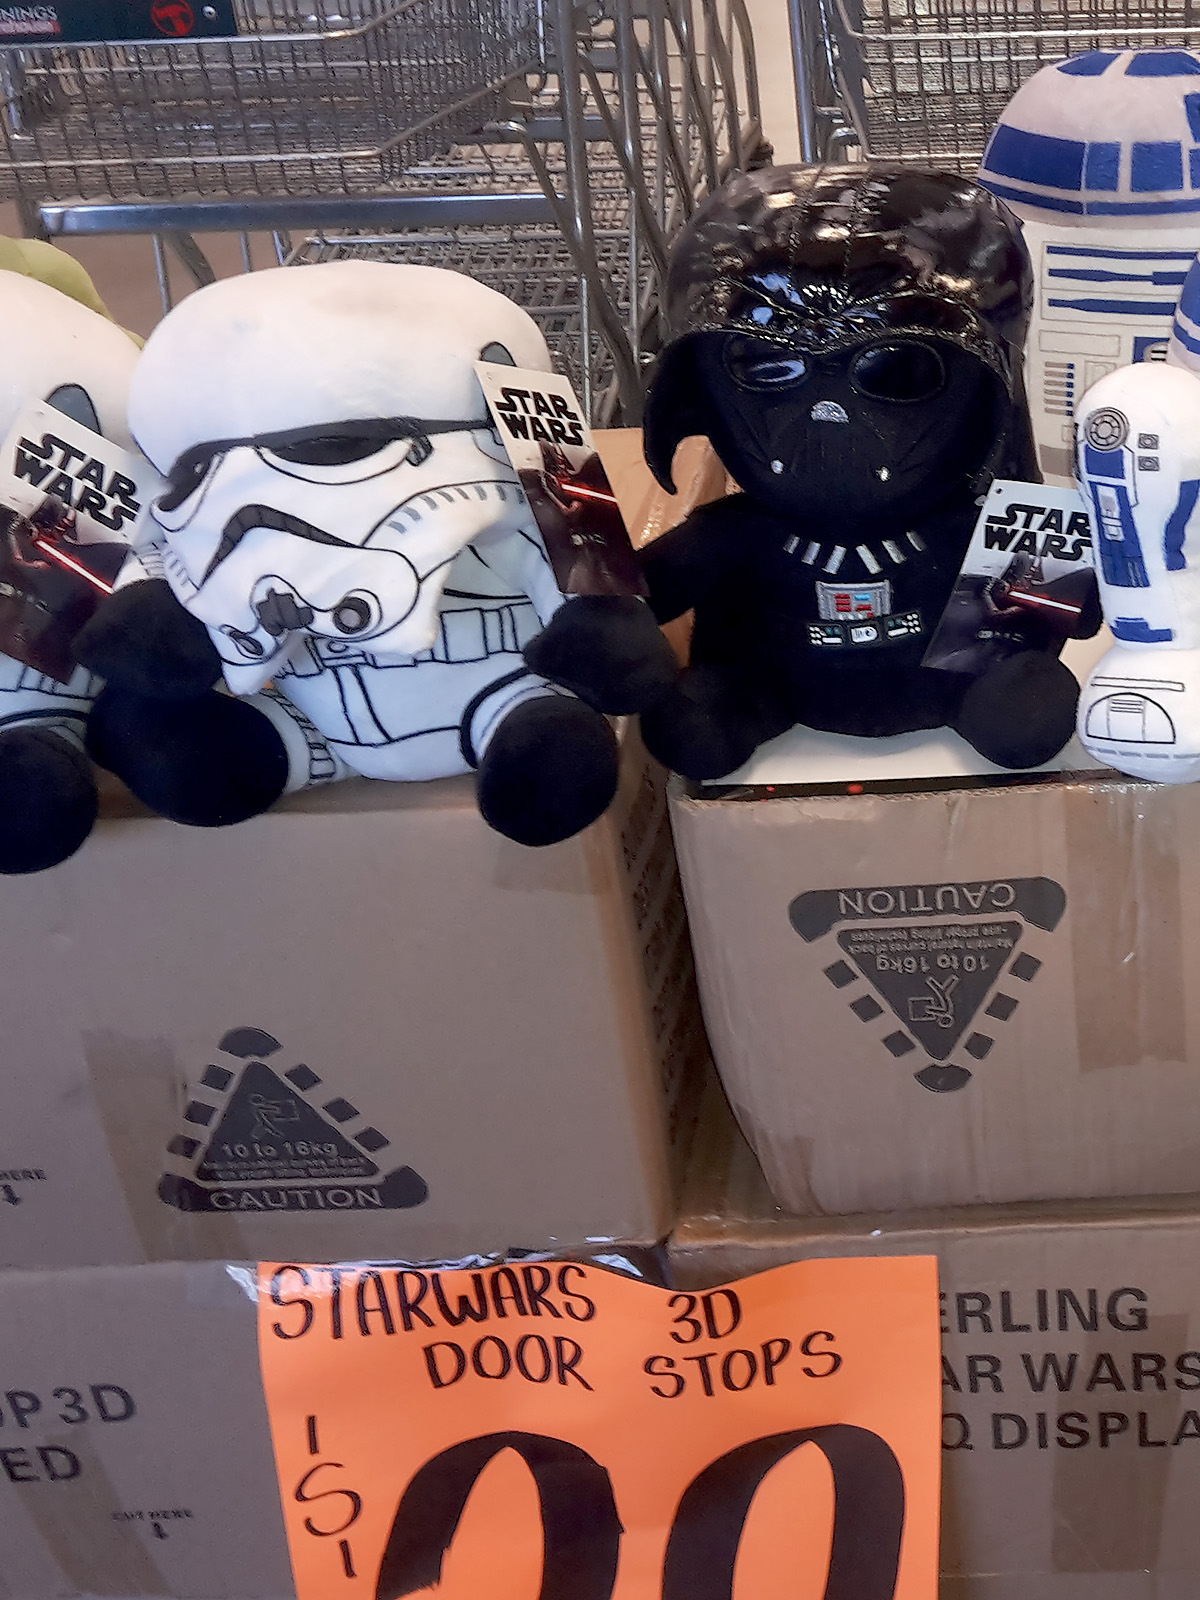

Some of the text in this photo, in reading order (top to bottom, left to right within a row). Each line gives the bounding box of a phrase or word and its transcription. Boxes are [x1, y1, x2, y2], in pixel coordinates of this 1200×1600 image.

[494, 387, 580, 421] STAR
[498, 412, 585, 447] WARS
[13, 445, 140, 531] WARS
[17, 433, 143, 514] STAR
[986, 503, 1091, 538] STAR
[984, 525, 1093, 561] WARS
[837, 883, 1016, 915] CAUTION
[210, 1188, 384, 1210] CAUTION
[271, 1264, 742, 1346] STARWARS 3D
[421, 1330, 843, 1399] DOOR STOPS
